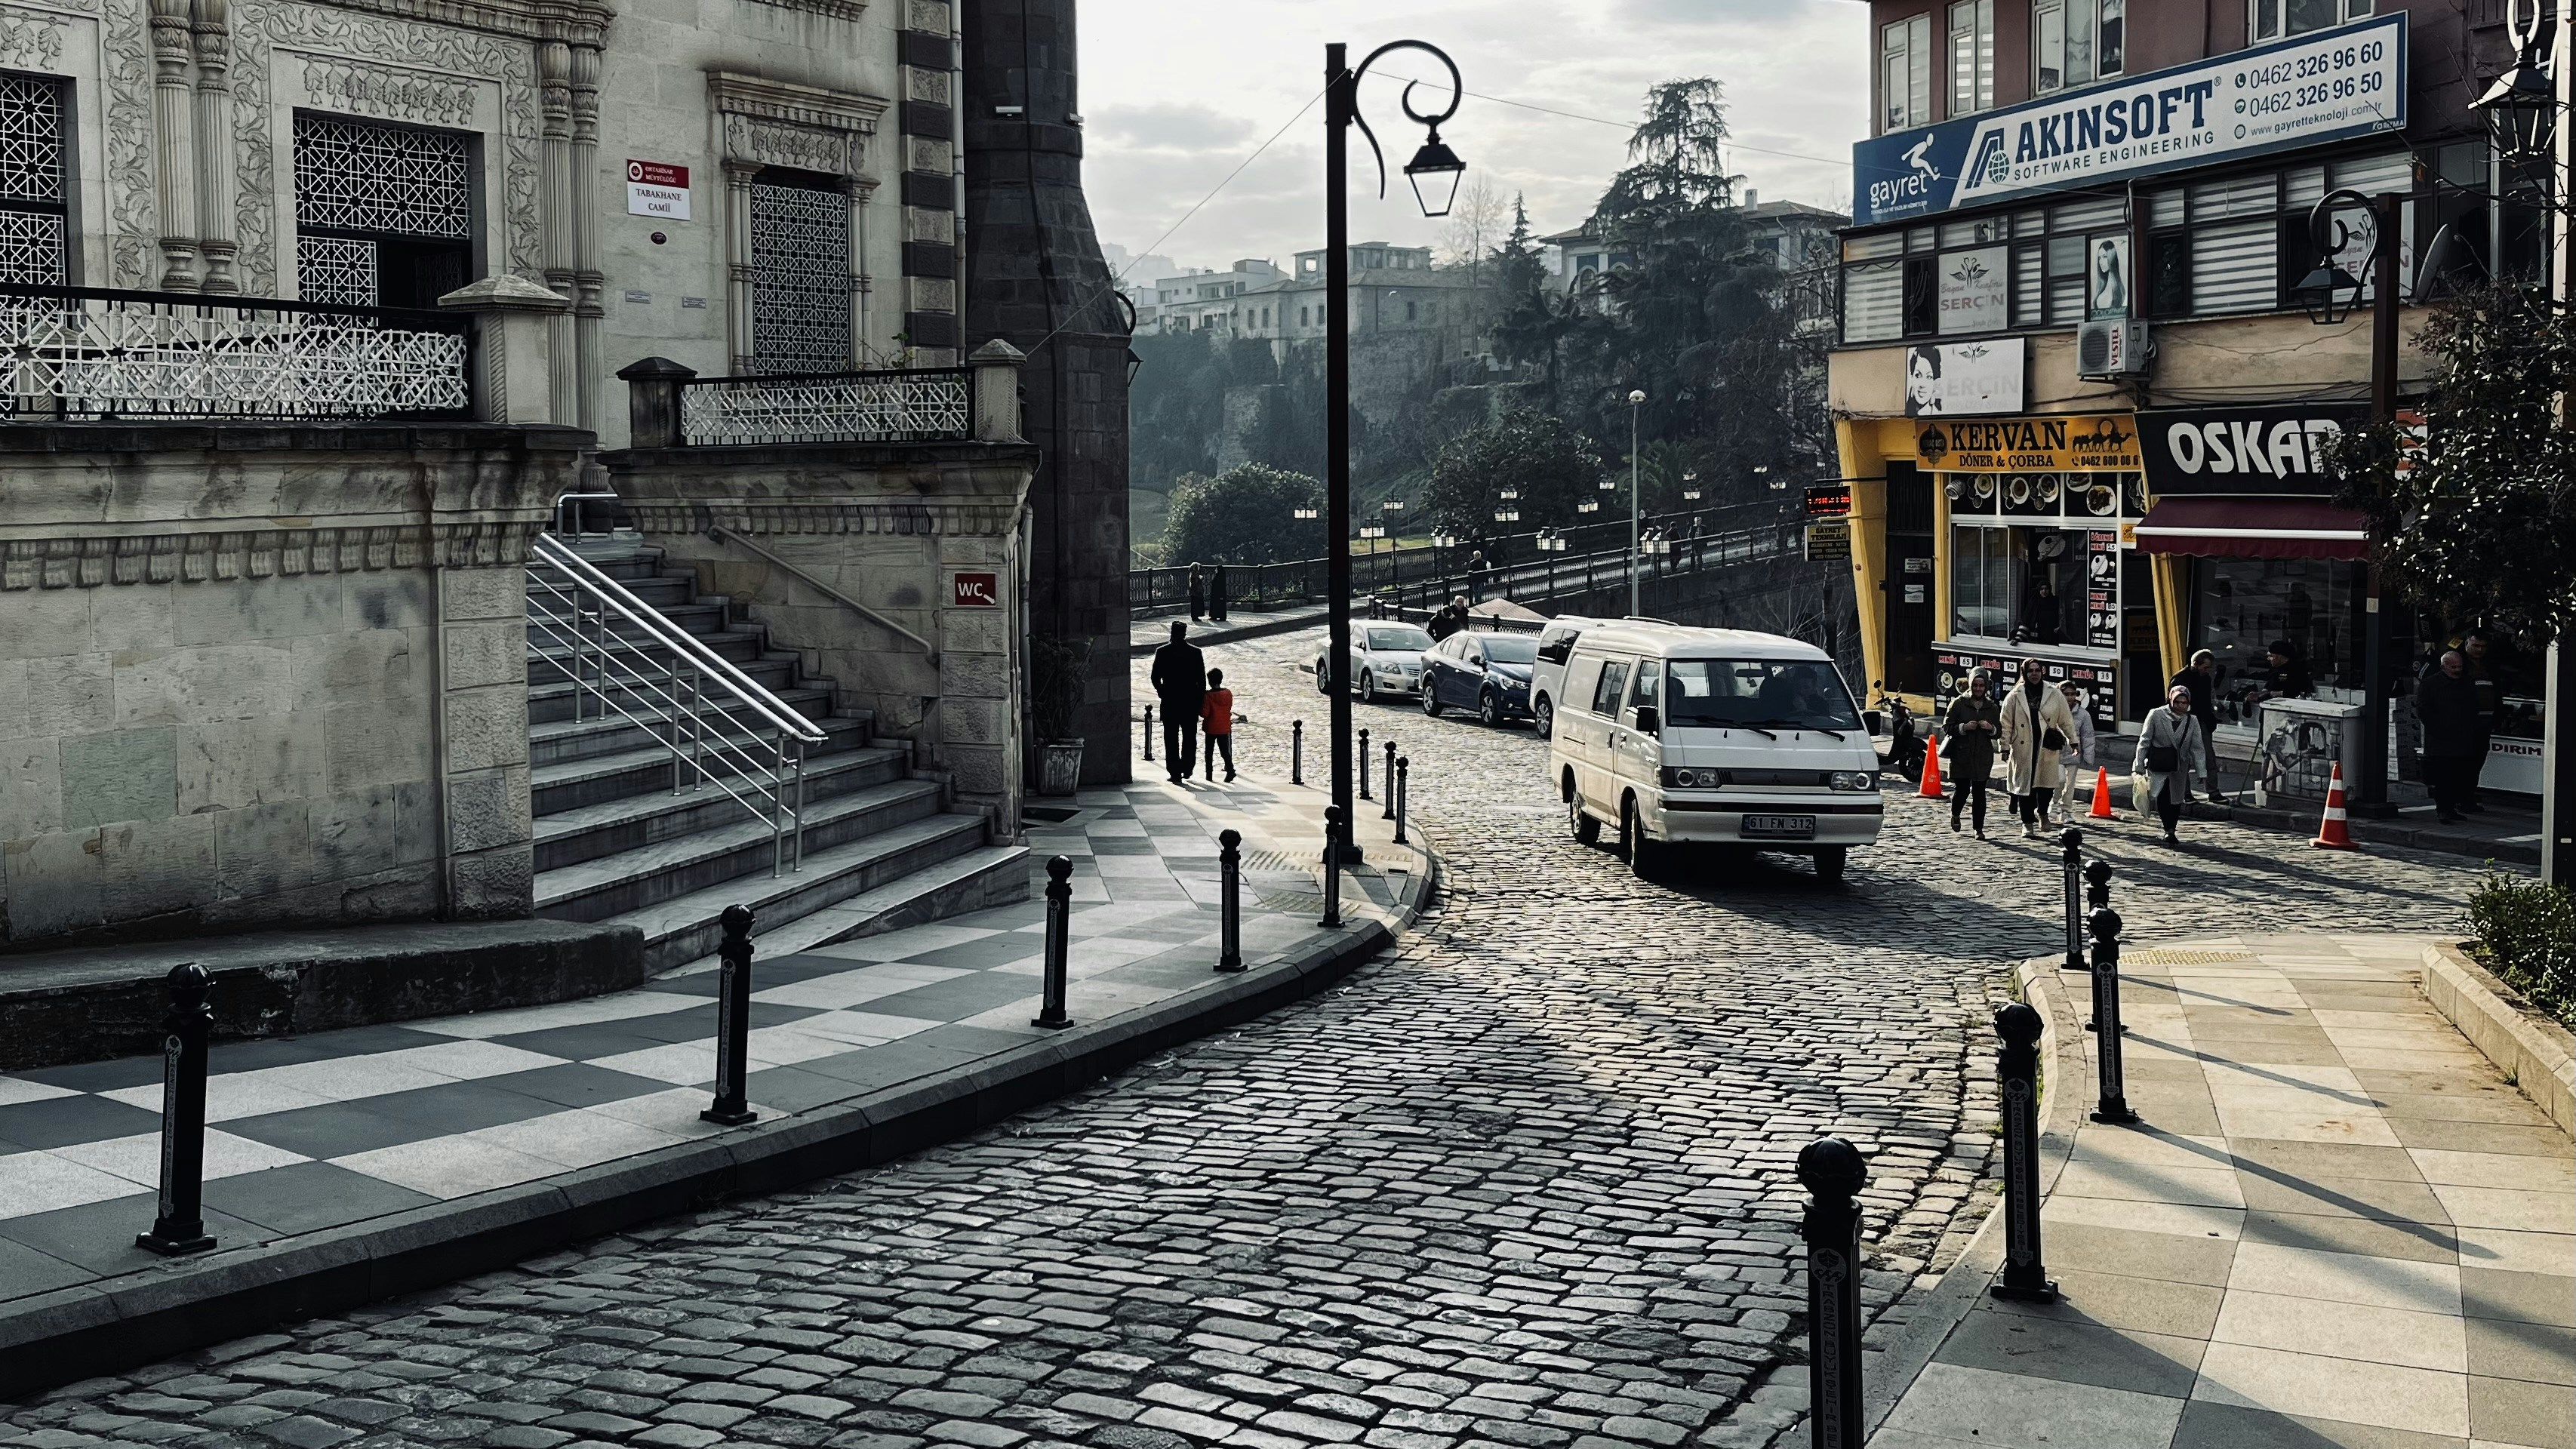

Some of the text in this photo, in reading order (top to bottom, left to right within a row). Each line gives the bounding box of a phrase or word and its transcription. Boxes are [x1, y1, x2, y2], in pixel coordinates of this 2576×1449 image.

[2250, 41, 2383, 89] 0462 326 96 60
[2250, 71, 2382, 117] 0462 326 96 50
[2015, 79, 2213, 164] AKINSOFT
[2014, 131, 2214, 180] SOFTWARE ENGINEERING
[636, 188, 682, 202] TABAKHANE
[1870, 170, 1928, 208] gayret
[1950, 420, 2067, 452] KERVAN
[1959, 453, 2055, 470] DÖNER & ÇORBA
[2491, 743, 2542, 755] DIRIM
[1750, 817, 1812, 829] 61 FN 312
